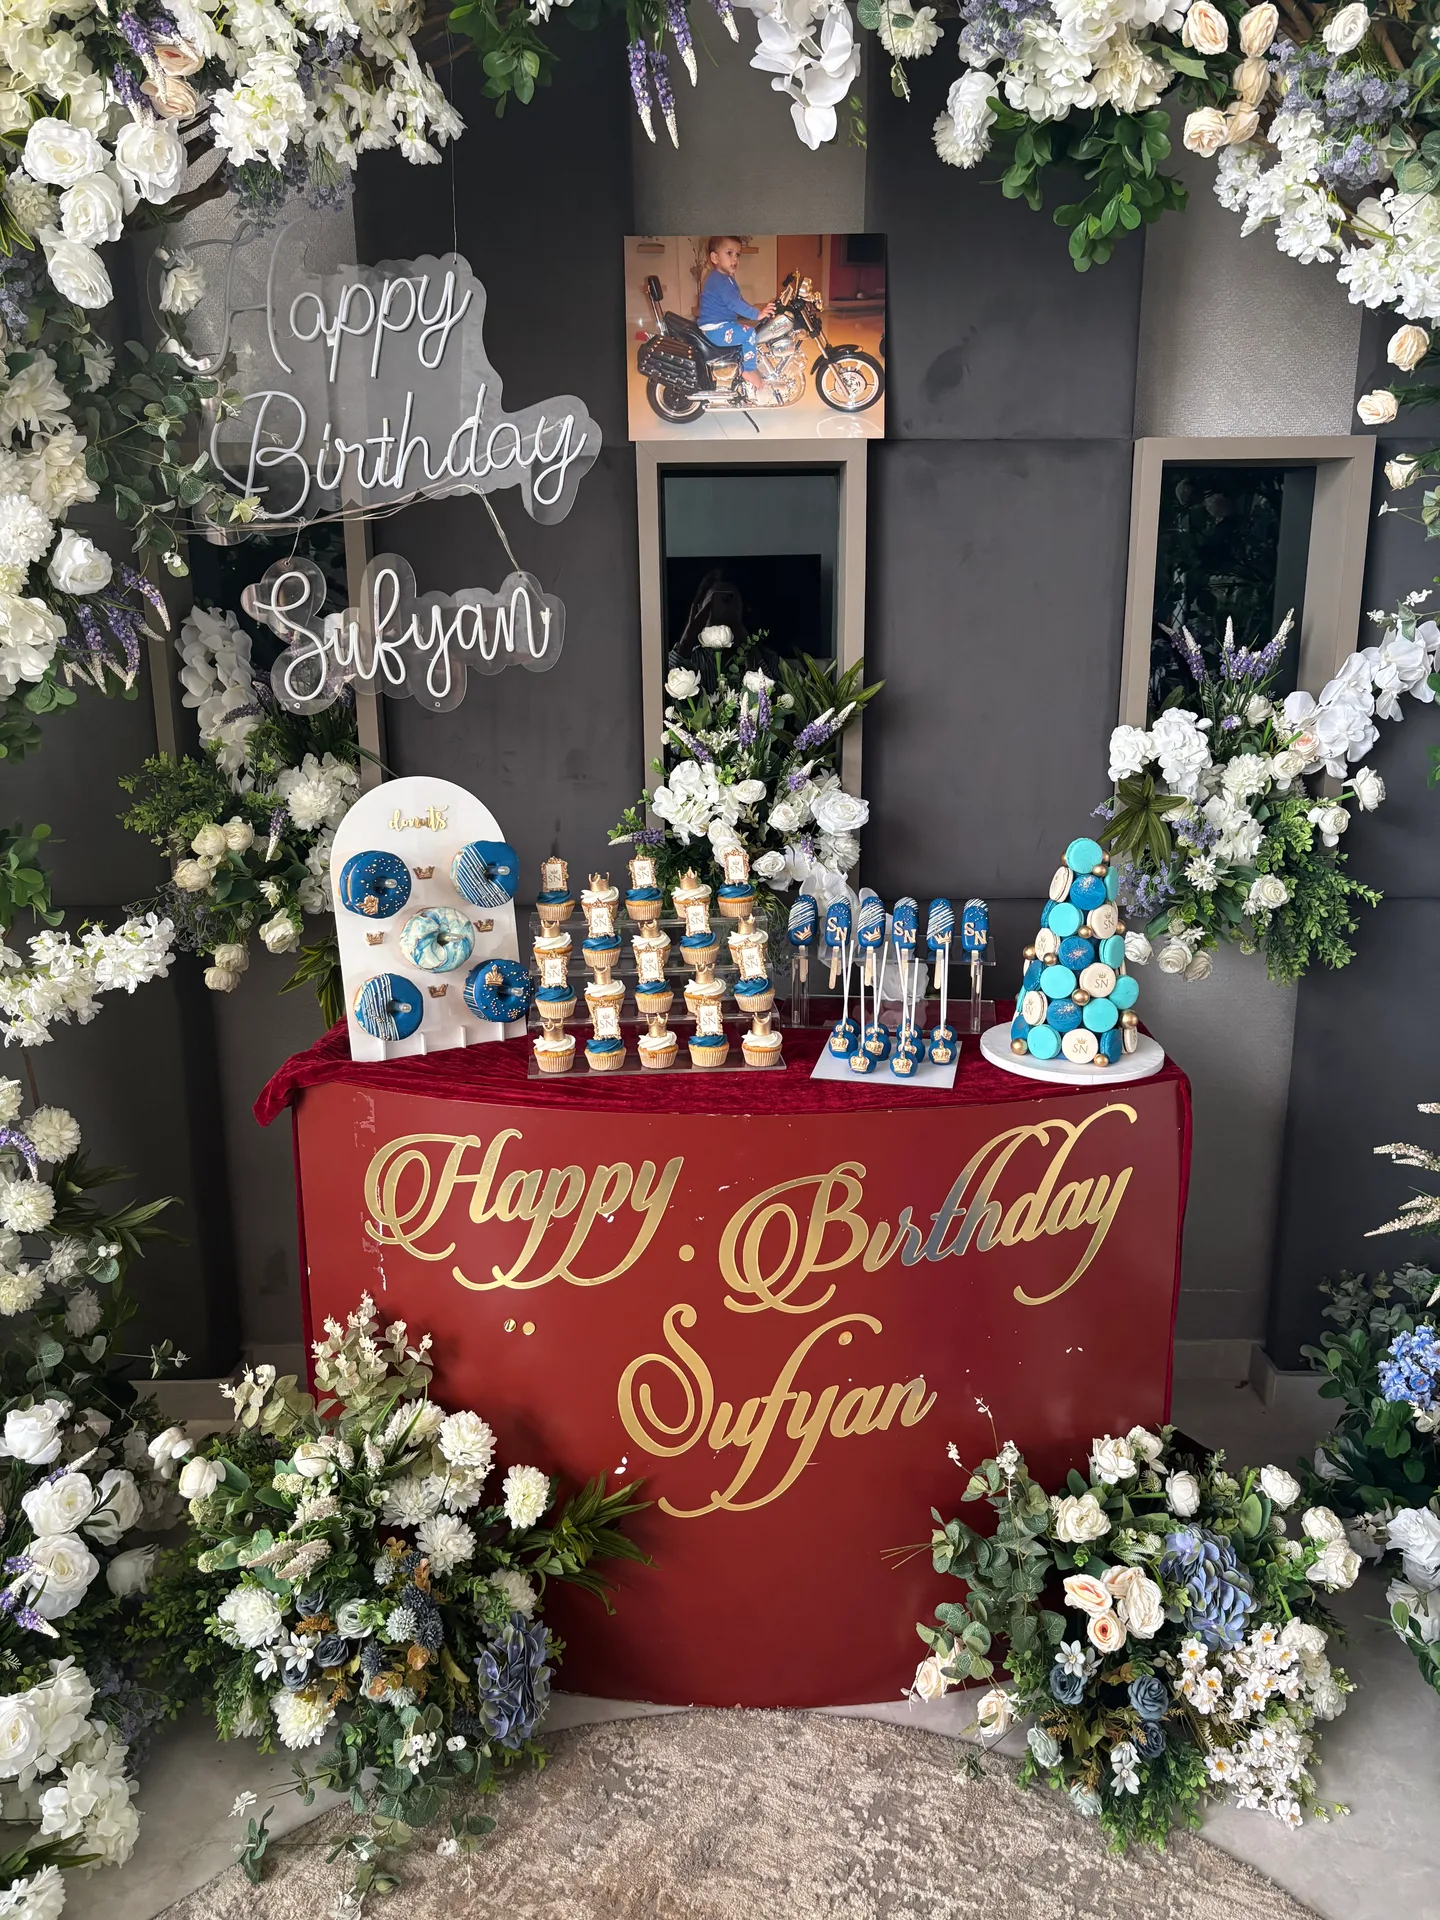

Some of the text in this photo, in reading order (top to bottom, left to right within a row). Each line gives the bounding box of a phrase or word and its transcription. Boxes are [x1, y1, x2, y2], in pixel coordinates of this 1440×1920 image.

[147, 217, 472, 383] Happy
[211, 383, 588, 519] Birthday
[253, 569, 550, 701] Sufyan
[389, 804, 449, 832] donuts
[730, 865, 743, 874] SN
[548, 874, 561, 883] SN
[637, 871, 650, 880] SN
[593, 919, 607, 928] SN
[691, 916, 704, 926] SN
[1104, 918, 1116, 929] SN
[827, 917, 847, 941] SN
[894, 920, 917, 943] SN
[964, 922, 987, 945] SN
[643, 963, 657, 972] SN
[745, 959, 759, 969] SN
[547, 969, 560, 979] SN
[1095, 979, 1109, 988] SN
[600, 1020, 614, 1028] SN
[703, 1017, 716, 1026] SN
[1072, 1044, 1089, 1054] SN
[364, 1103, 1138, 1313] Happy Birthday
[618, 1303, 938, 1519] Sufyan
